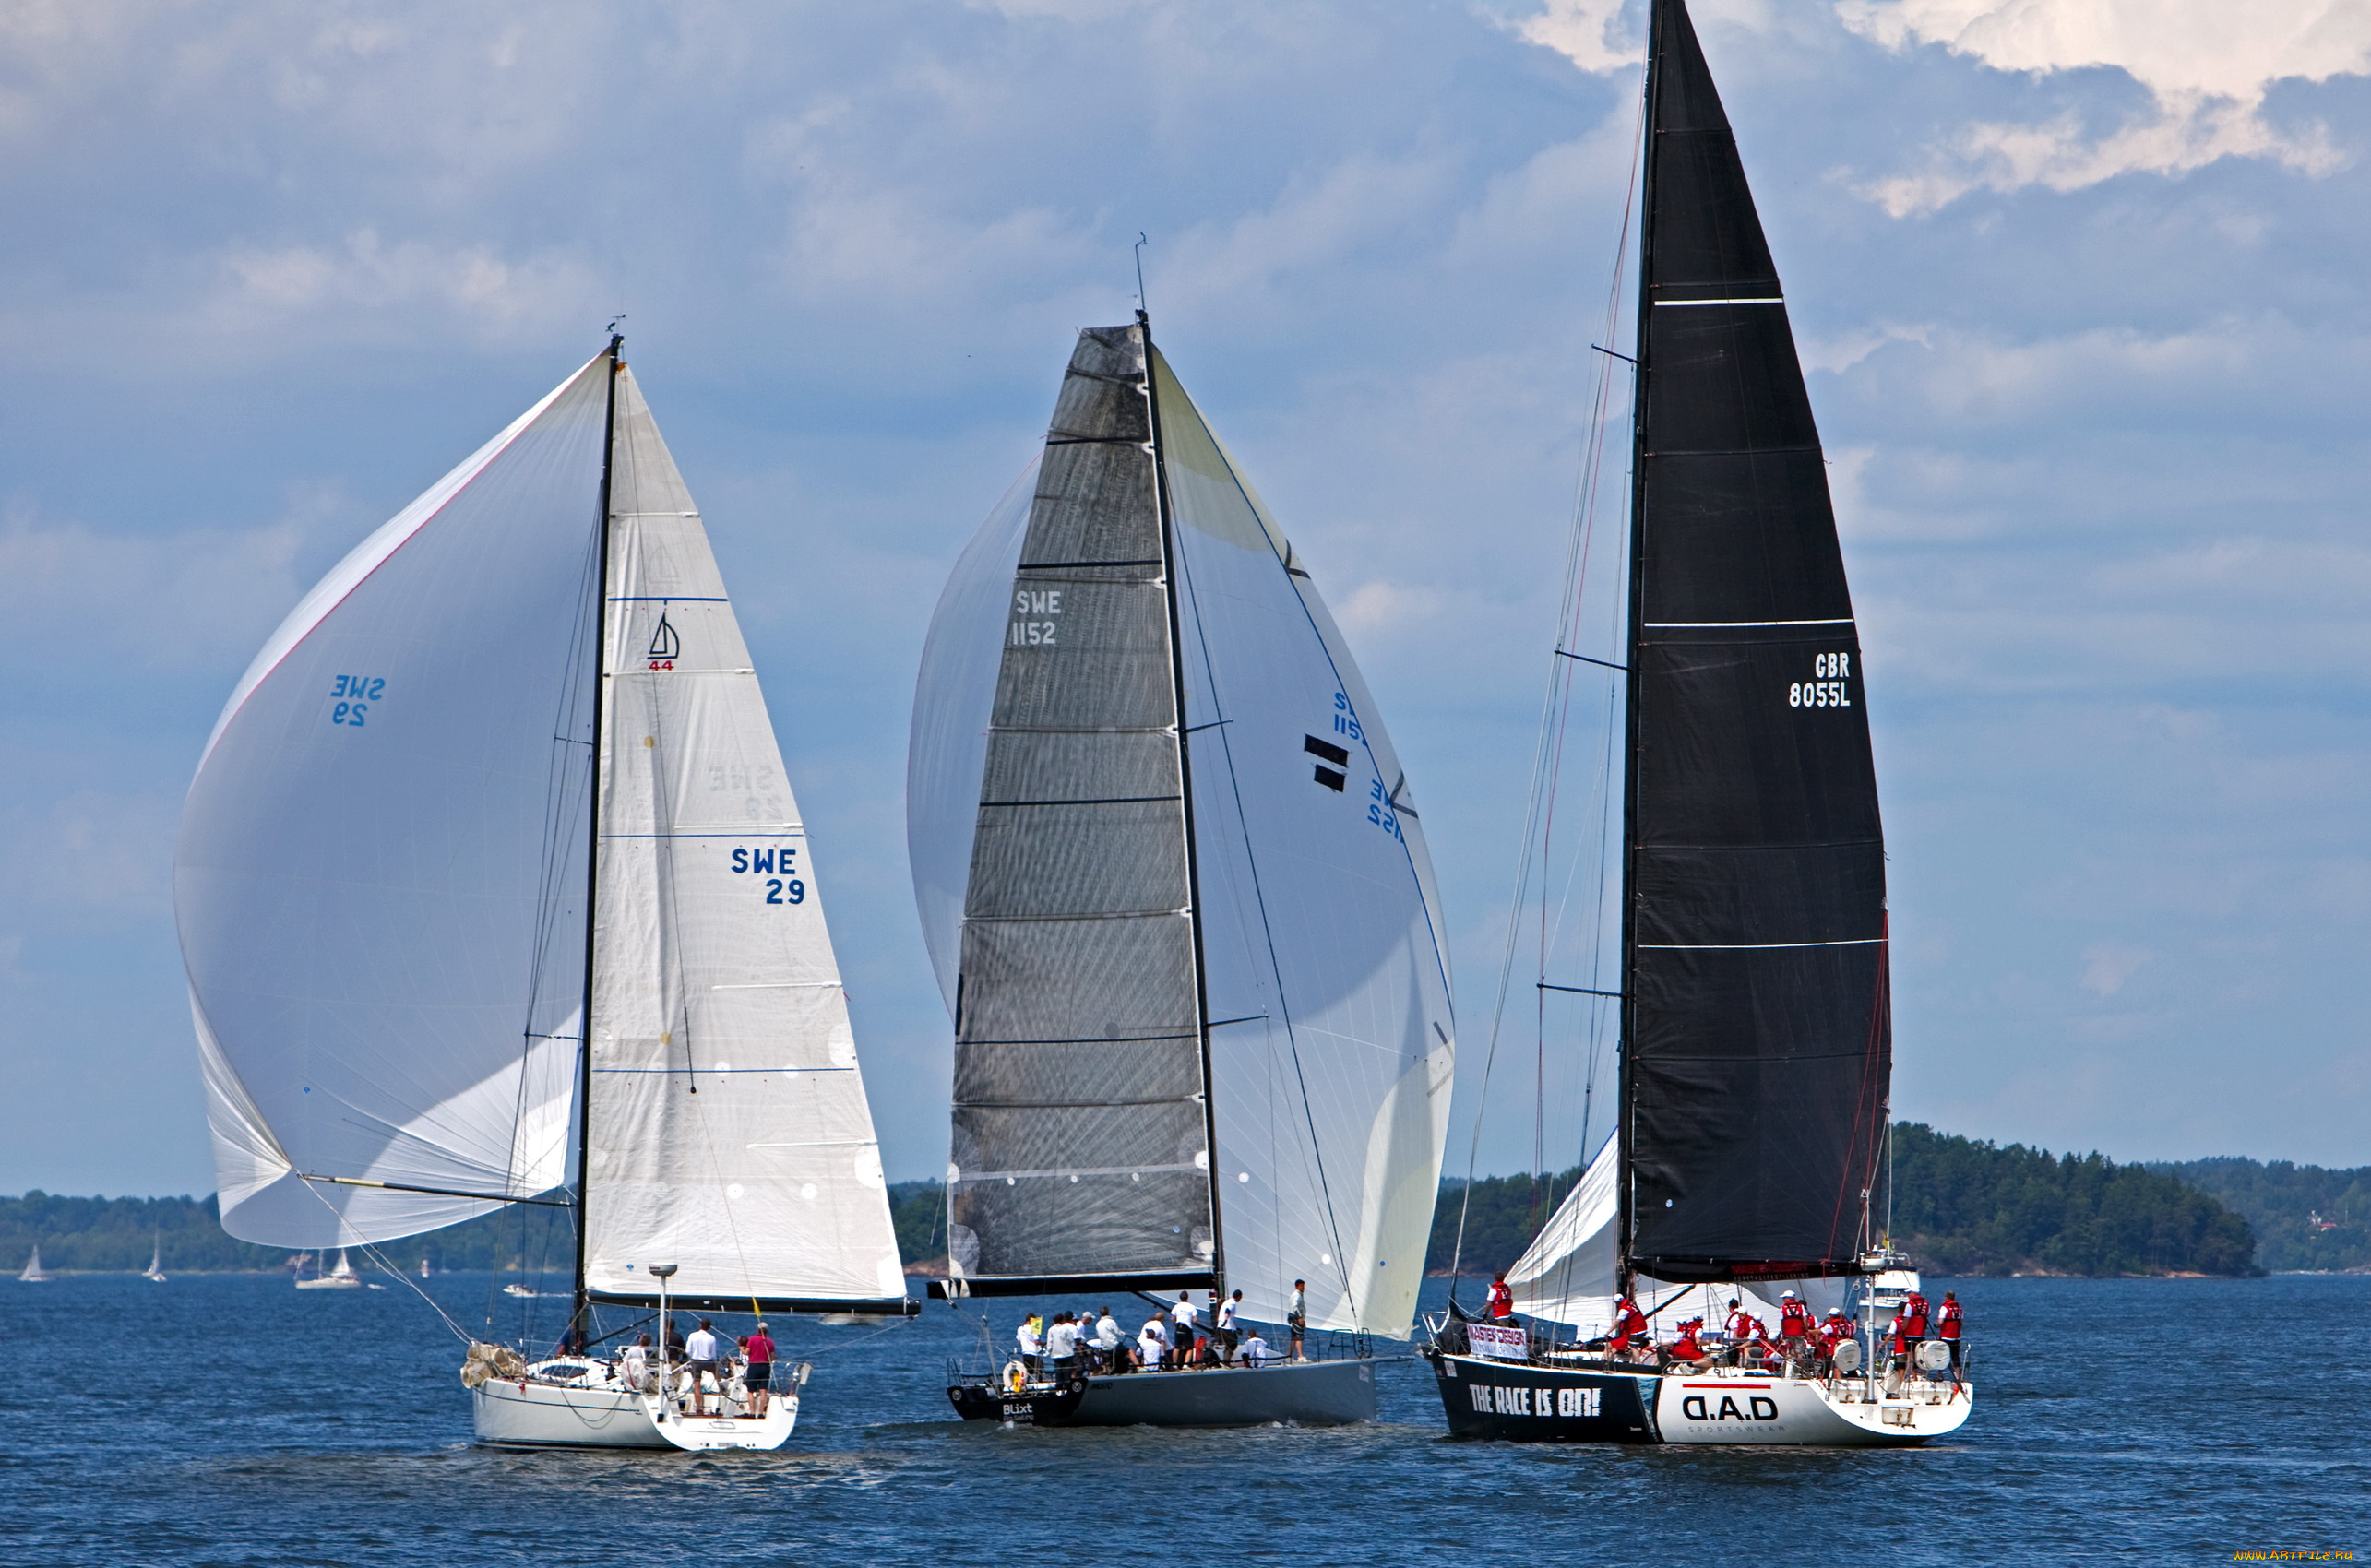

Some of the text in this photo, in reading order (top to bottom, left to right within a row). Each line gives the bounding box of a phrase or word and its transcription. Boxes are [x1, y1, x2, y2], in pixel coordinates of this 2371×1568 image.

[1016, 590, 1061, 614] SWE
[1012, 621, 1055, 645] 1152
[649, 660, 674, 671] 44
[1815, 652, 1850, 678] GBR
[1789, 682, 1851, 707] 8055L
[1334, 714, 1368, 747] 115
[731, 848, 796, 874] SWE
[765, 879, 804, 905] 29
[1469, 1384, 1494, 1413] THE
[1495, 1386, 1531, 1416] RACE
[1535, 1388, 1554, 1417] IS
[1688, 1425, 1786, 1433] SPORTSWEAR
